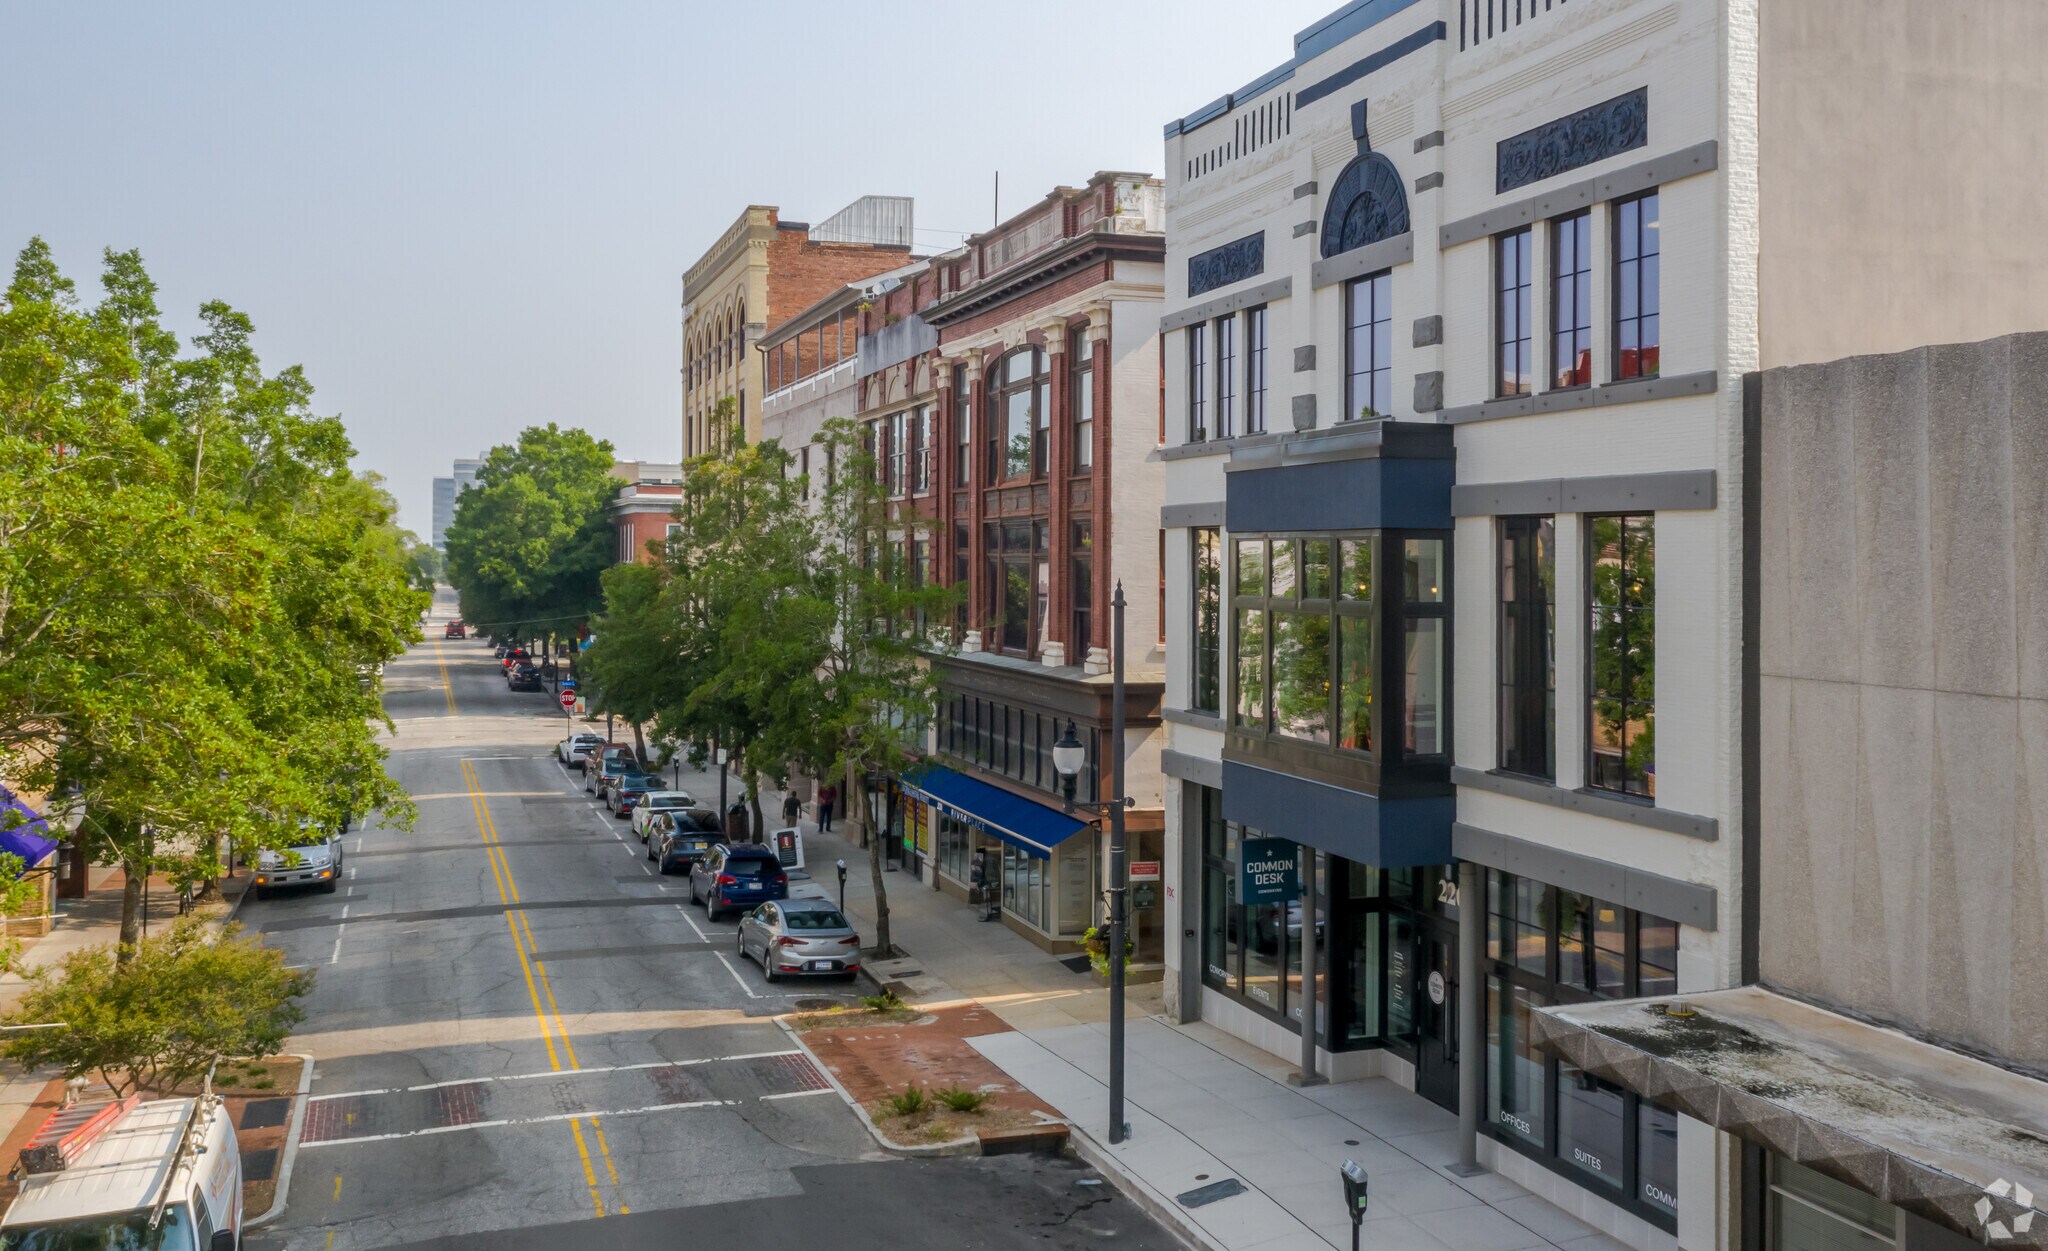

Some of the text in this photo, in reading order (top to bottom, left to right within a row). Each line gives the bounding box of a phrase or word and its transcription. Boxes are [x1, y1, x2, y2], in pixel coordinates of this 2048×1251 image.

[1246, 859, 1294, 874] COMMON
[1255, 872, 1285, 885] DESK
[1252, 985, 1270, 1002] EVENTS
[1500, 1111, 1531, 1135] OFFICES
[1574, 1147, 1602, 1171] SUITES
